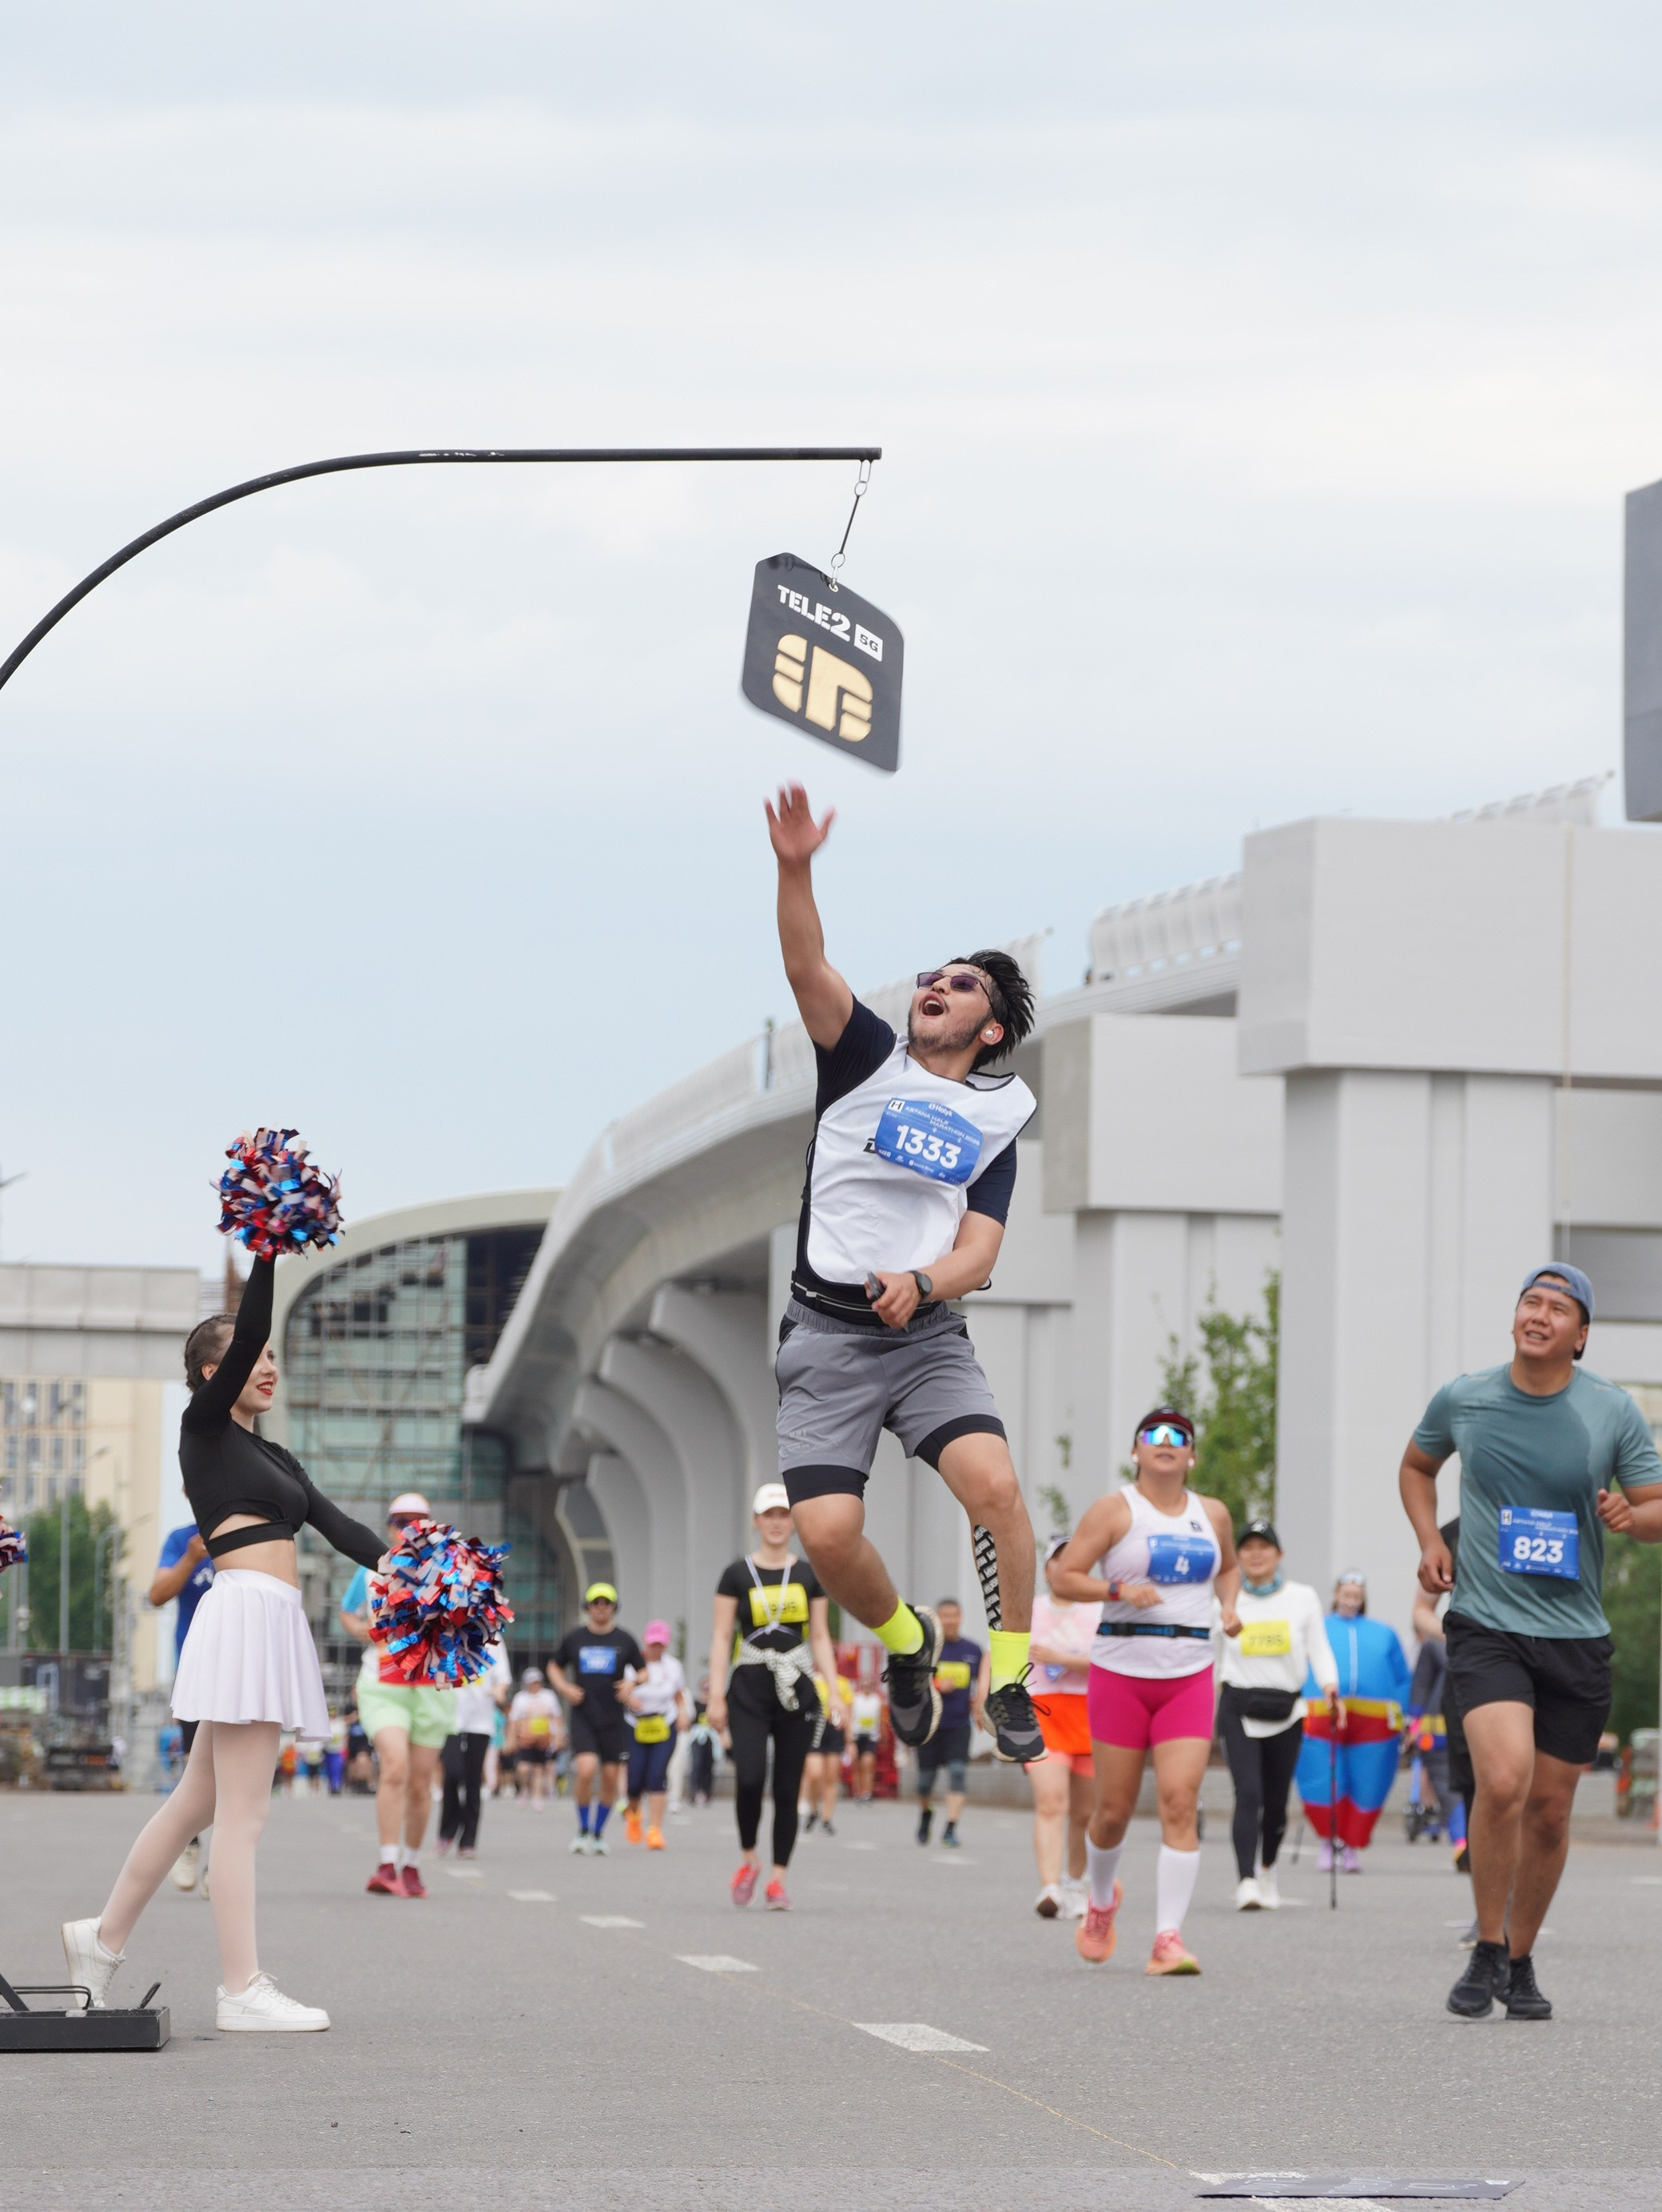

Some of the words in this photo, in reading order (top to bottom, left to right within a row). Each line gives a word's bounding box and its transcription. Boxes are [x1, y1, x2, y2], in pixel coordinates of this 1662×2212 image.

[777, 584, 851, 643] TELE2
[859, 635, 879, 653] 5G
[896, 1124, 962, 1169] 1333
[1174, 1554, 1190, 1575] 4
[1513, 1535, 1564, 1564] 823
